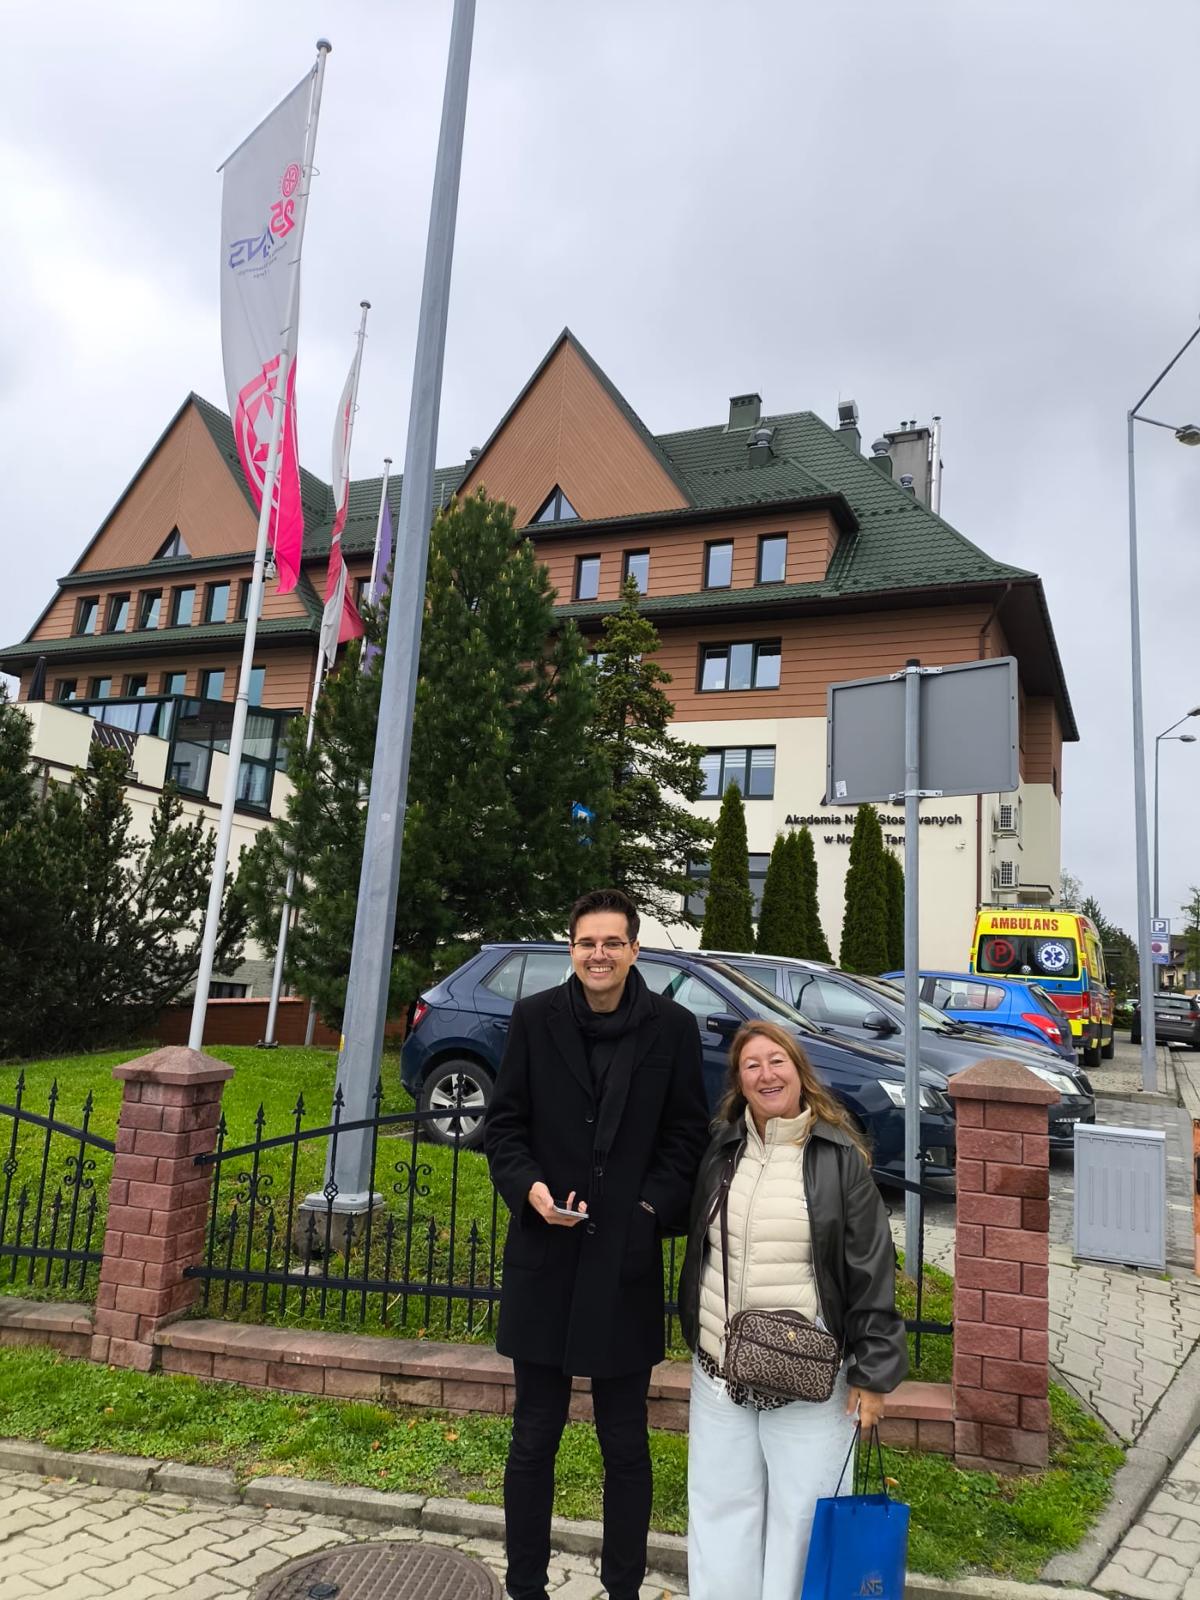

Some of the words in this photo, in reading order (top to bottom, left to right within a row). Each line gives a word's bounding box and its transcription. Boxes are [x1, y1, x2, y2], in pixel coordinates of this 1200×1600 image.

[785, 814, 841, 825] Akademia
[824, 836, 833, 845] w
[991, 917, 1060, 931] AMBULANS
[1155, 922, 1164, 931] P
[994, 942, 1007, 961] P
